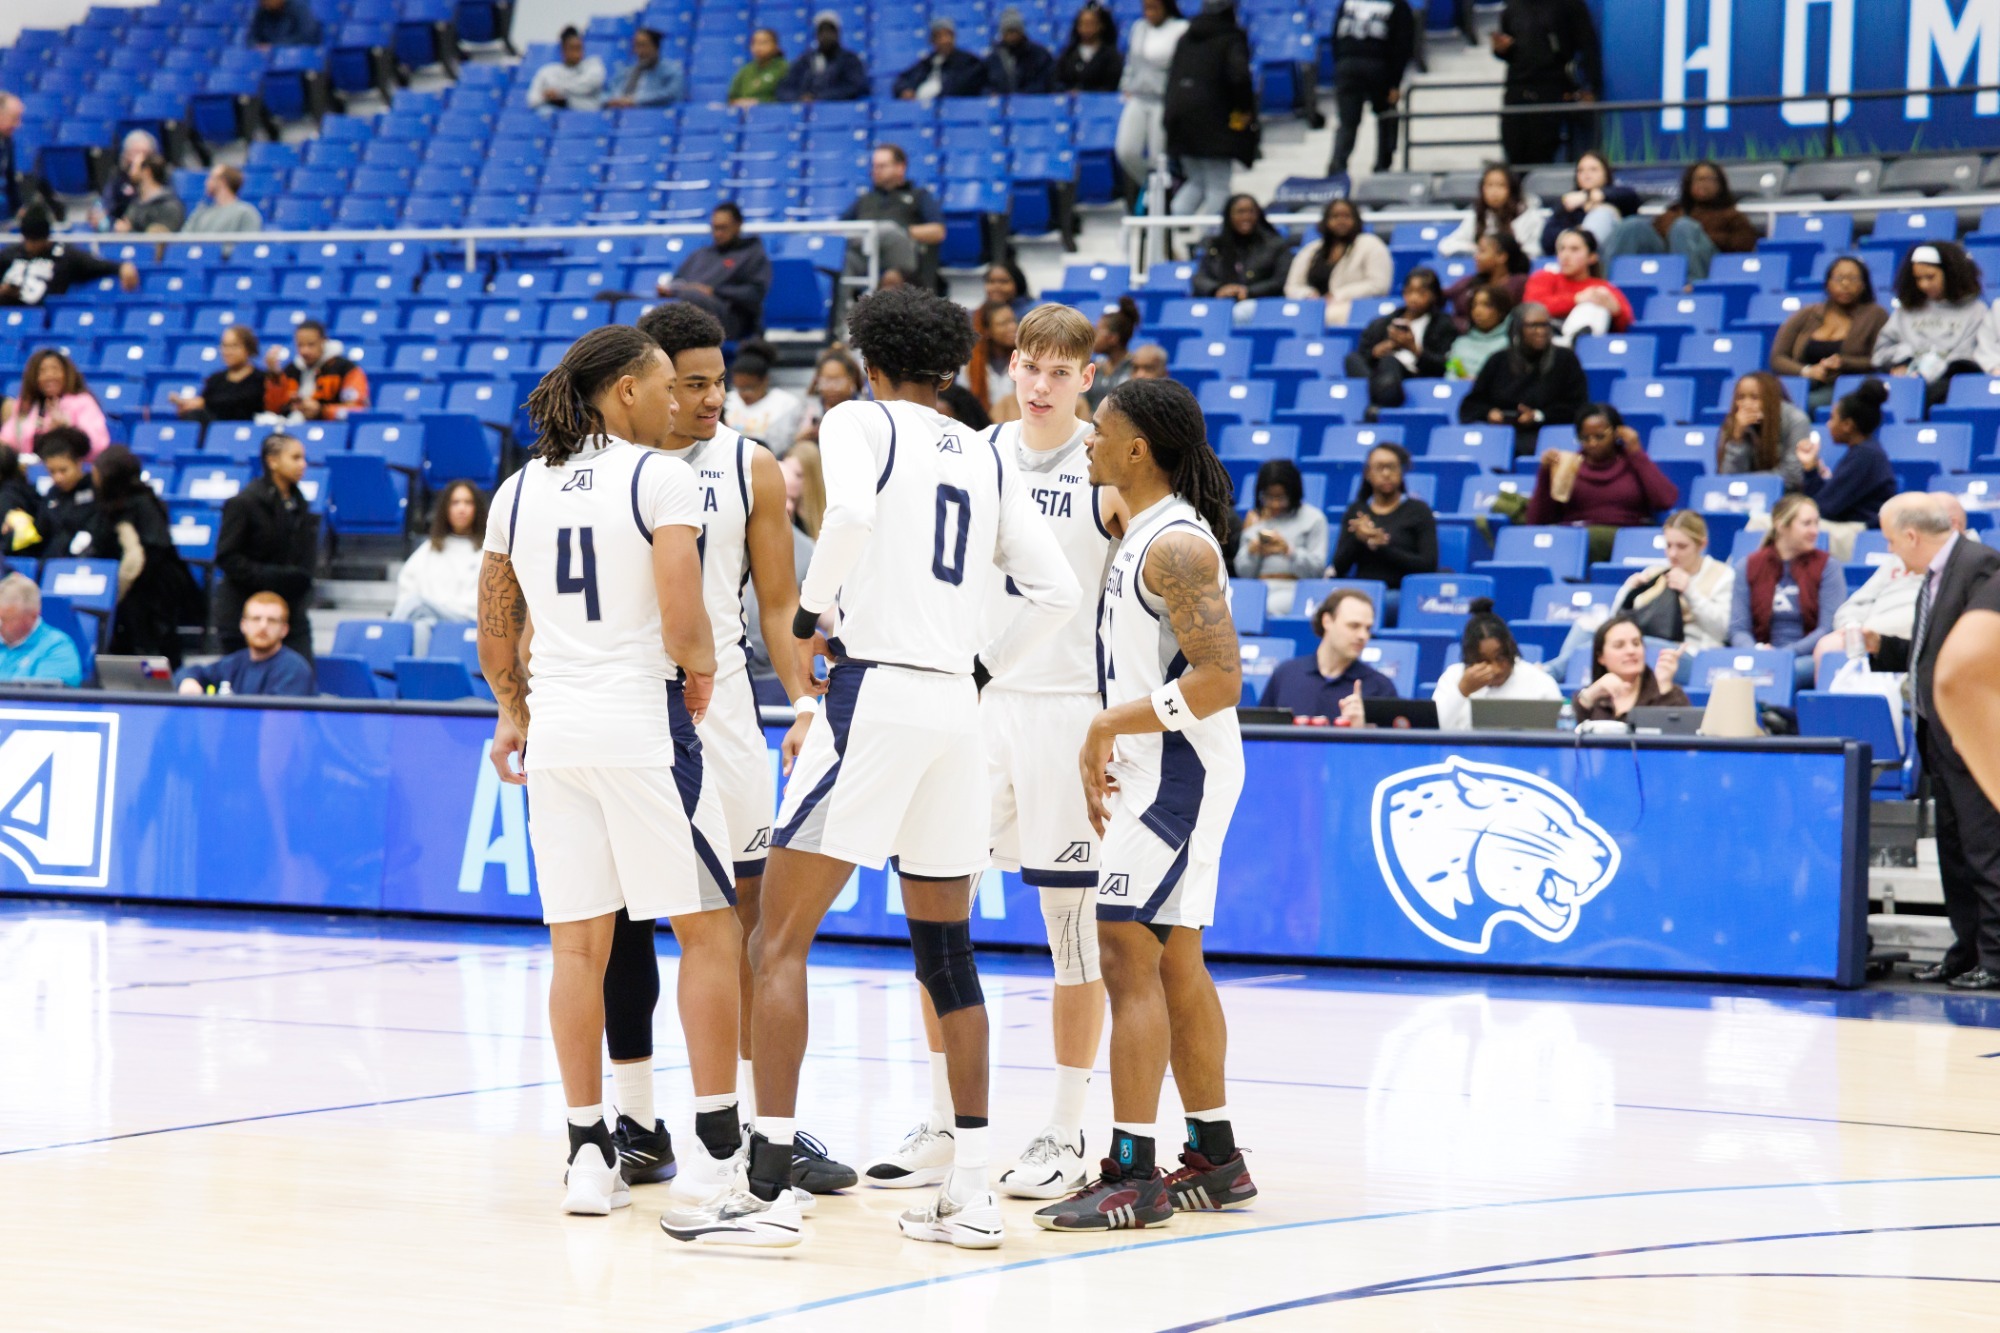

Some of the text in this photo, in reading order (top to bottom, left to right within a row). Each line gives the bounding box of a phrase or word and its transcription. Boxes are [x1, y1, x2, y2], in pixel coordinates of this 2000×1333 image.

[700, 470, 724, 479] PBC
[1059, 474, 1082, 484] PBC
[932, 483, 971, 587] 0
[556, 526, 602, 622] 4
